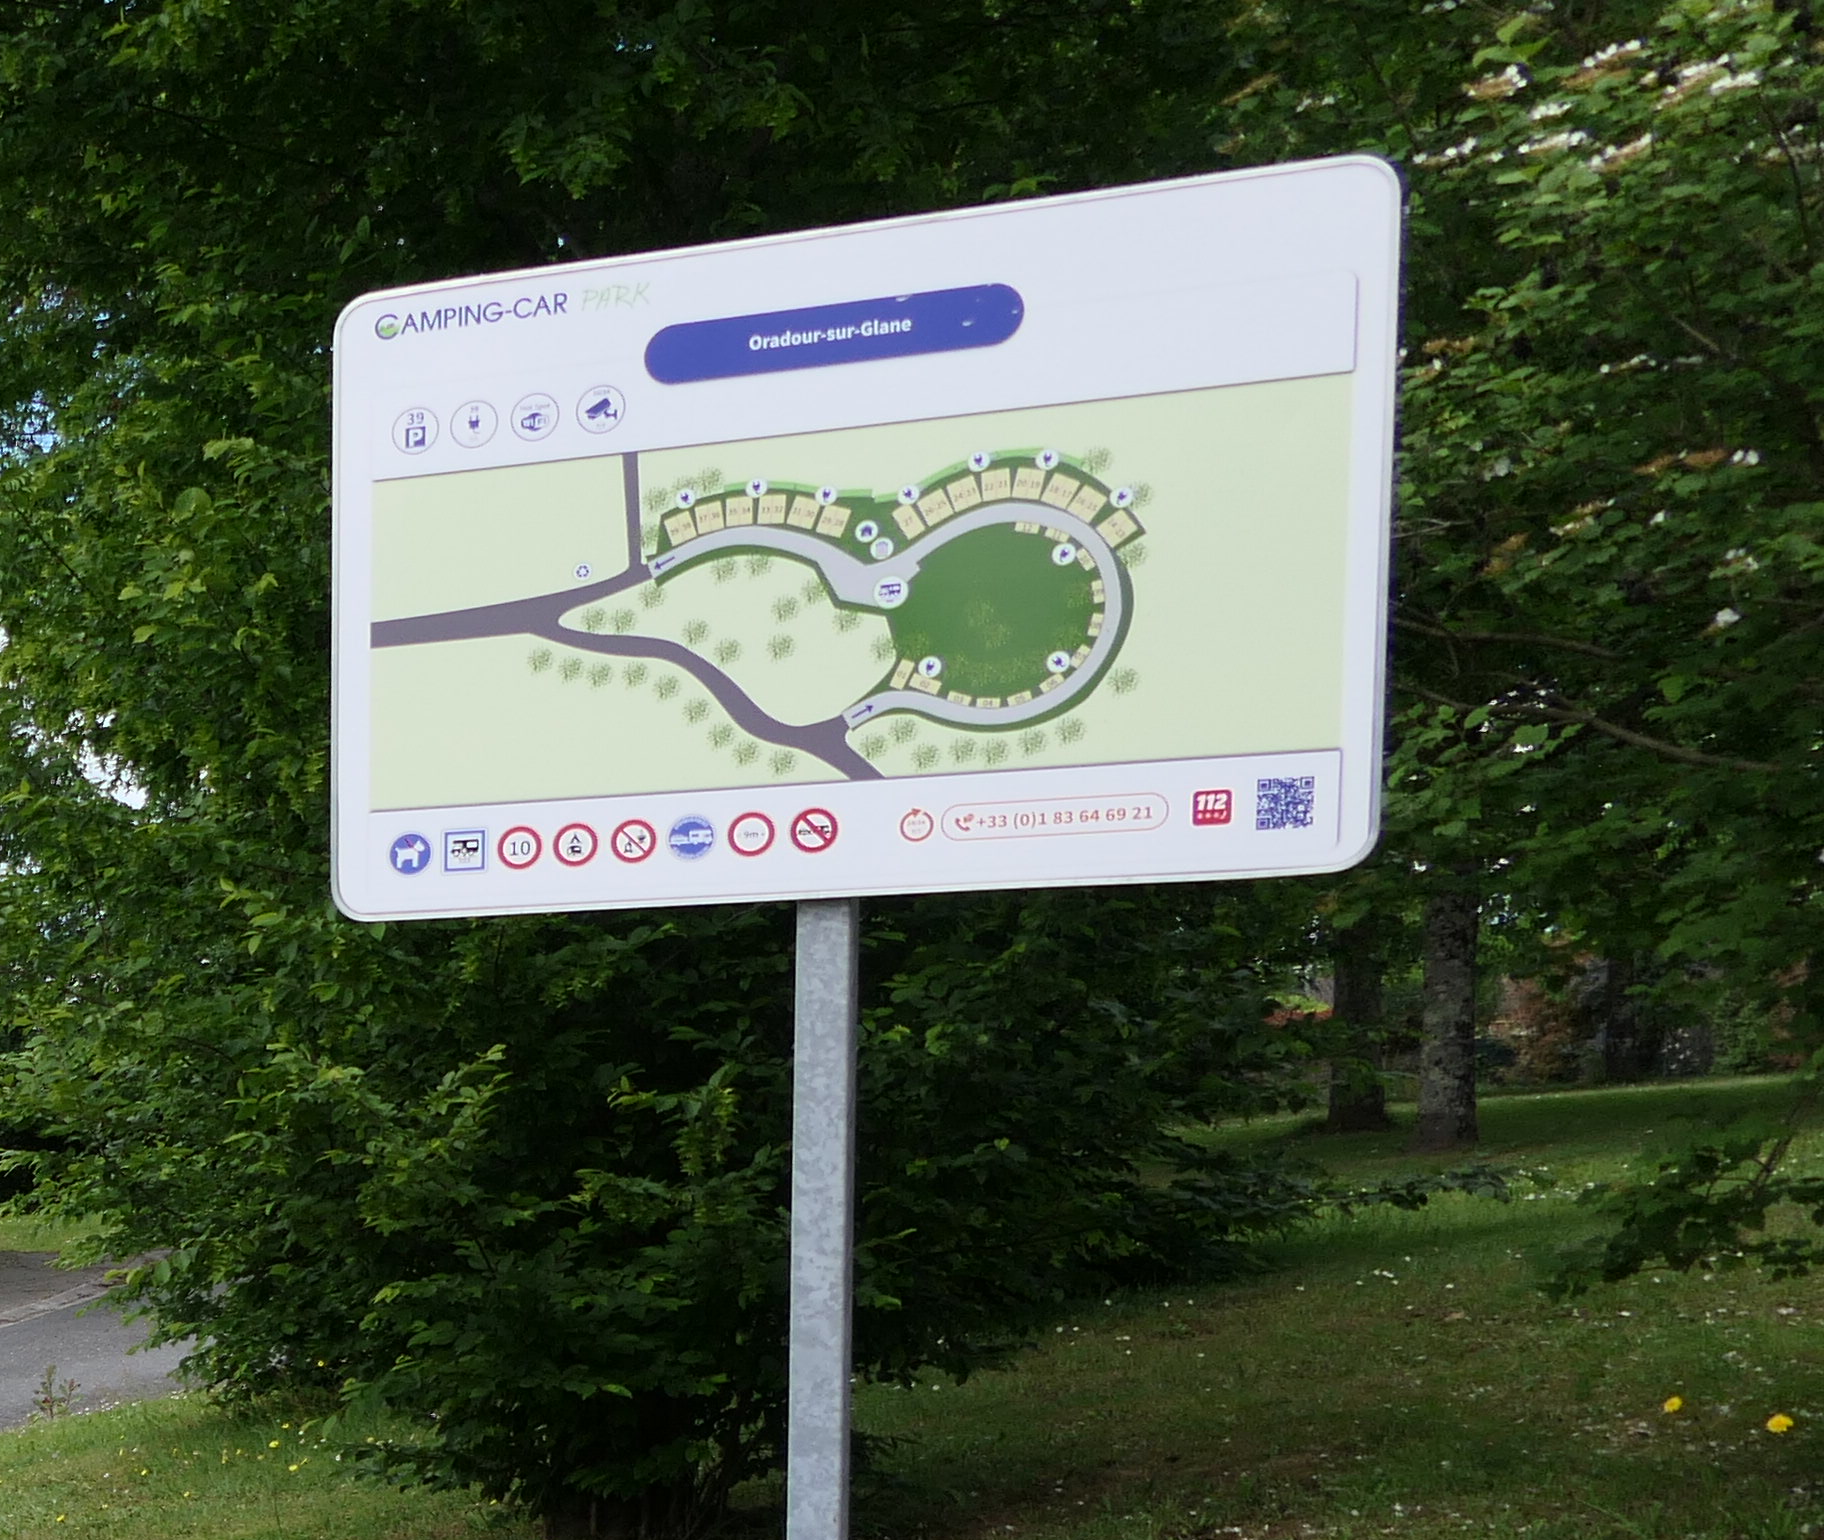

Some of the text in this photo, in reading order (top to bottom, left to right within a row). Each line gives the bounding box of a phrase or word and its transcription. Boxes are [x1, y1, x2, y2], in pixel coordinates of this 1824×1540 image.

[374, 281, 652, 341] CAMPING-CAR PARK
[749, 317, 913, 351] Oradour-sur-Glane
[406, 411, 425, 426] 39
[1195, 793, 1227, 811] 112
[975, 806, 1153, 830] +33 (0)1 83 64 69 21
[508, 840, 531, 858] 10
